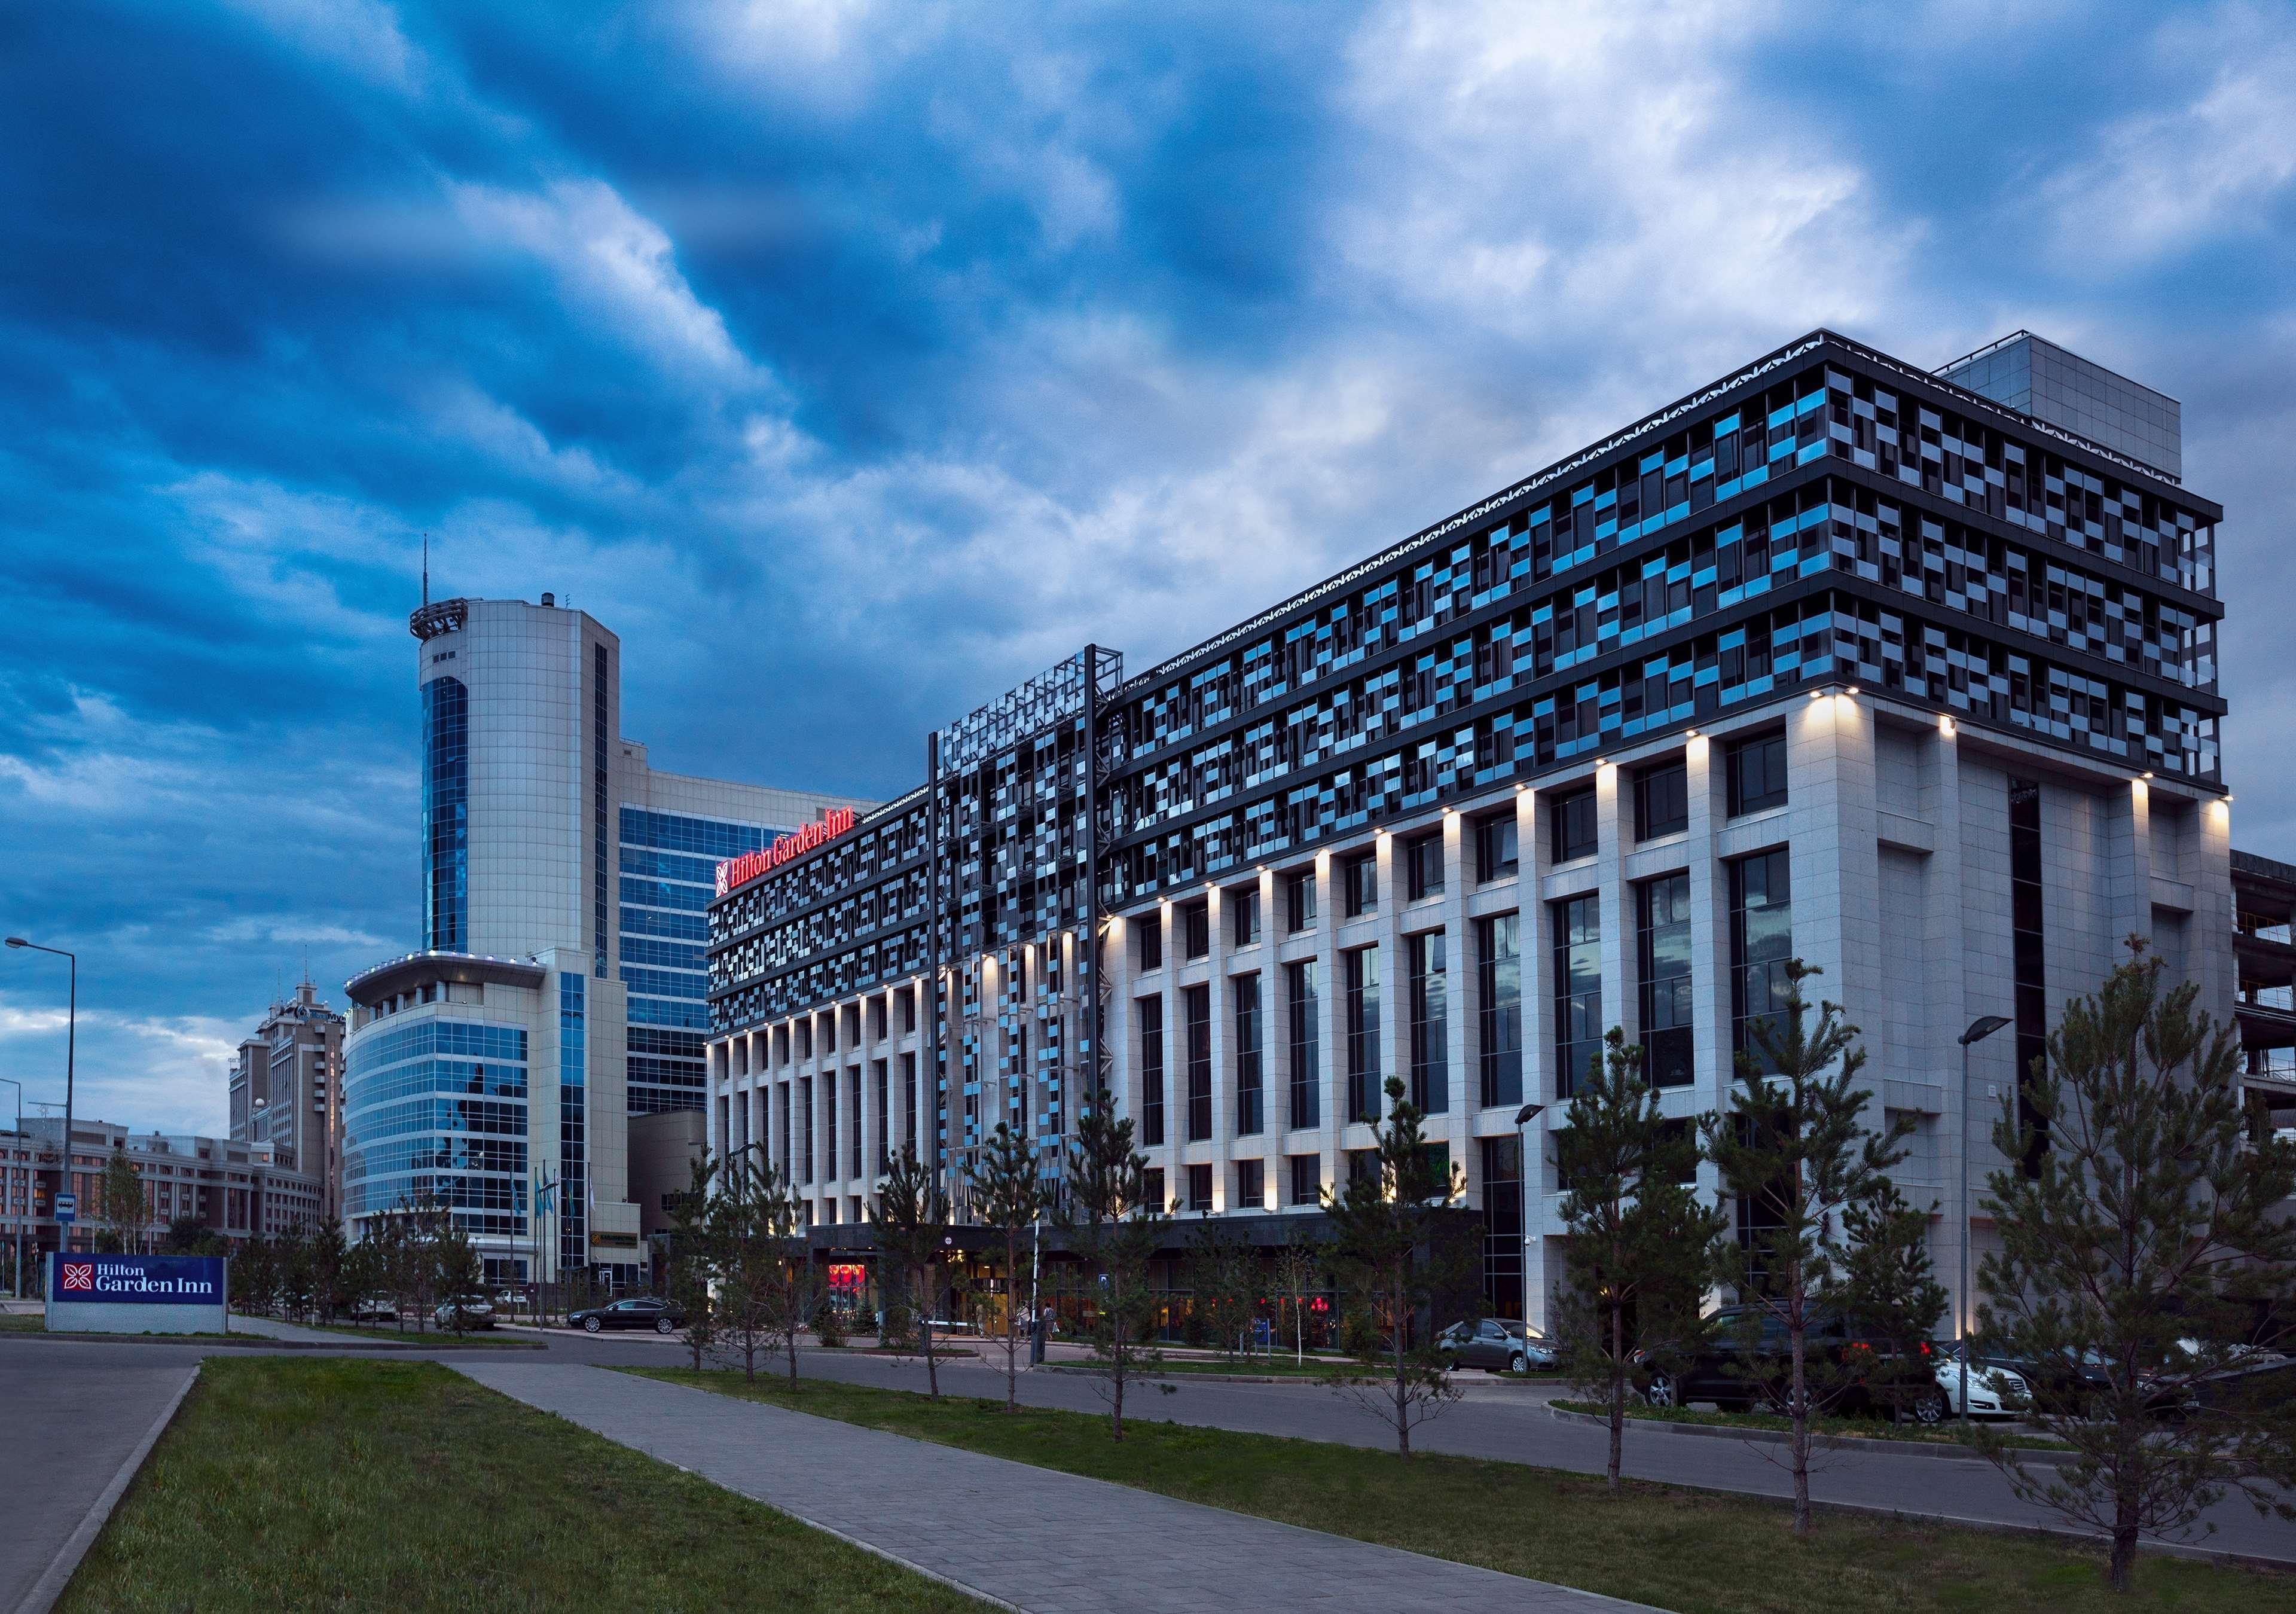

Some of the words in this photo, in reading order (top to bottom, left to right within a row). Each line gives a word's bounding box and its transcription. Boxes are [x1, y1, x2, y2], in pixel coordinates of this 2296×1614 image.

[731, 850, 772, 888] Hilton
[773, 823, 824, 866] Garden
[825, 807, 854, 840] Inn
[97, 1264, 144, 1276] Hilton
[96, 1276, 173, 1292] Garden
[176, 1277, 213, 1293] Inn
